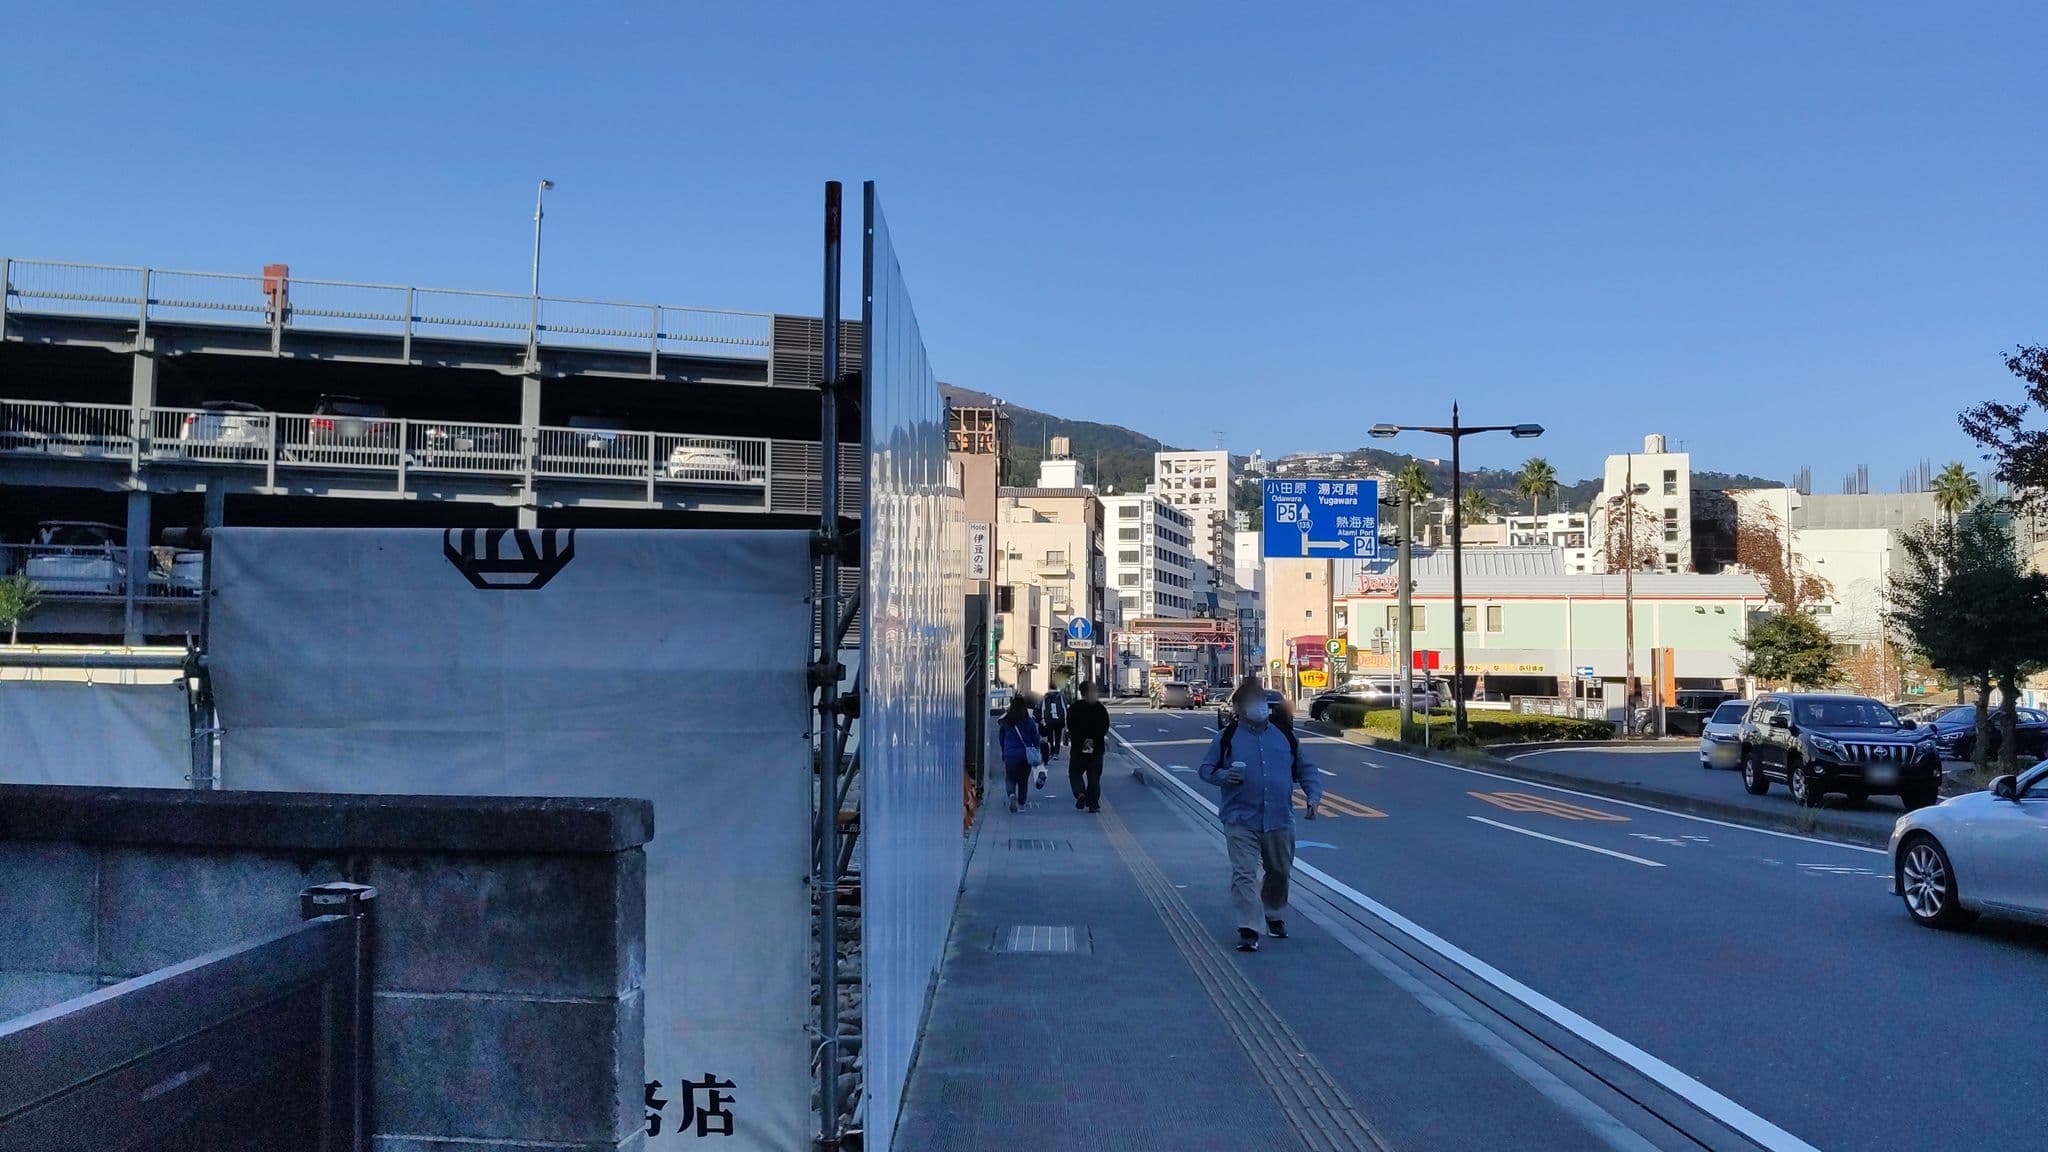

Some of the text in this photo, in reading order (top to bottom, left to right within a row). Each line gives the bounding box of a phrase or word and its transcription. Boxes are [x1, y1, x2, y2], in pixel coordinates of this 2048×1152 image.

[1267, 482, 1307, 495] 小田原
[1318, 483, 1358, 495] 湯河原
[1271, 494, 1302, 503] Odawara
[1318, 497, 1358, 506] Yugawara
[1278, 504, 1296, 521] P5
[970, 523, 987, 531] Hotel
[1299, 521, 1310, 529] 135
[1336, 516, 1375, 528] 熱海港
[1337, 529, 1375, 537] Atami Port
[1356, 538, 1373, 555] P4
[973, 533, 985, 574] 伊豆の海
